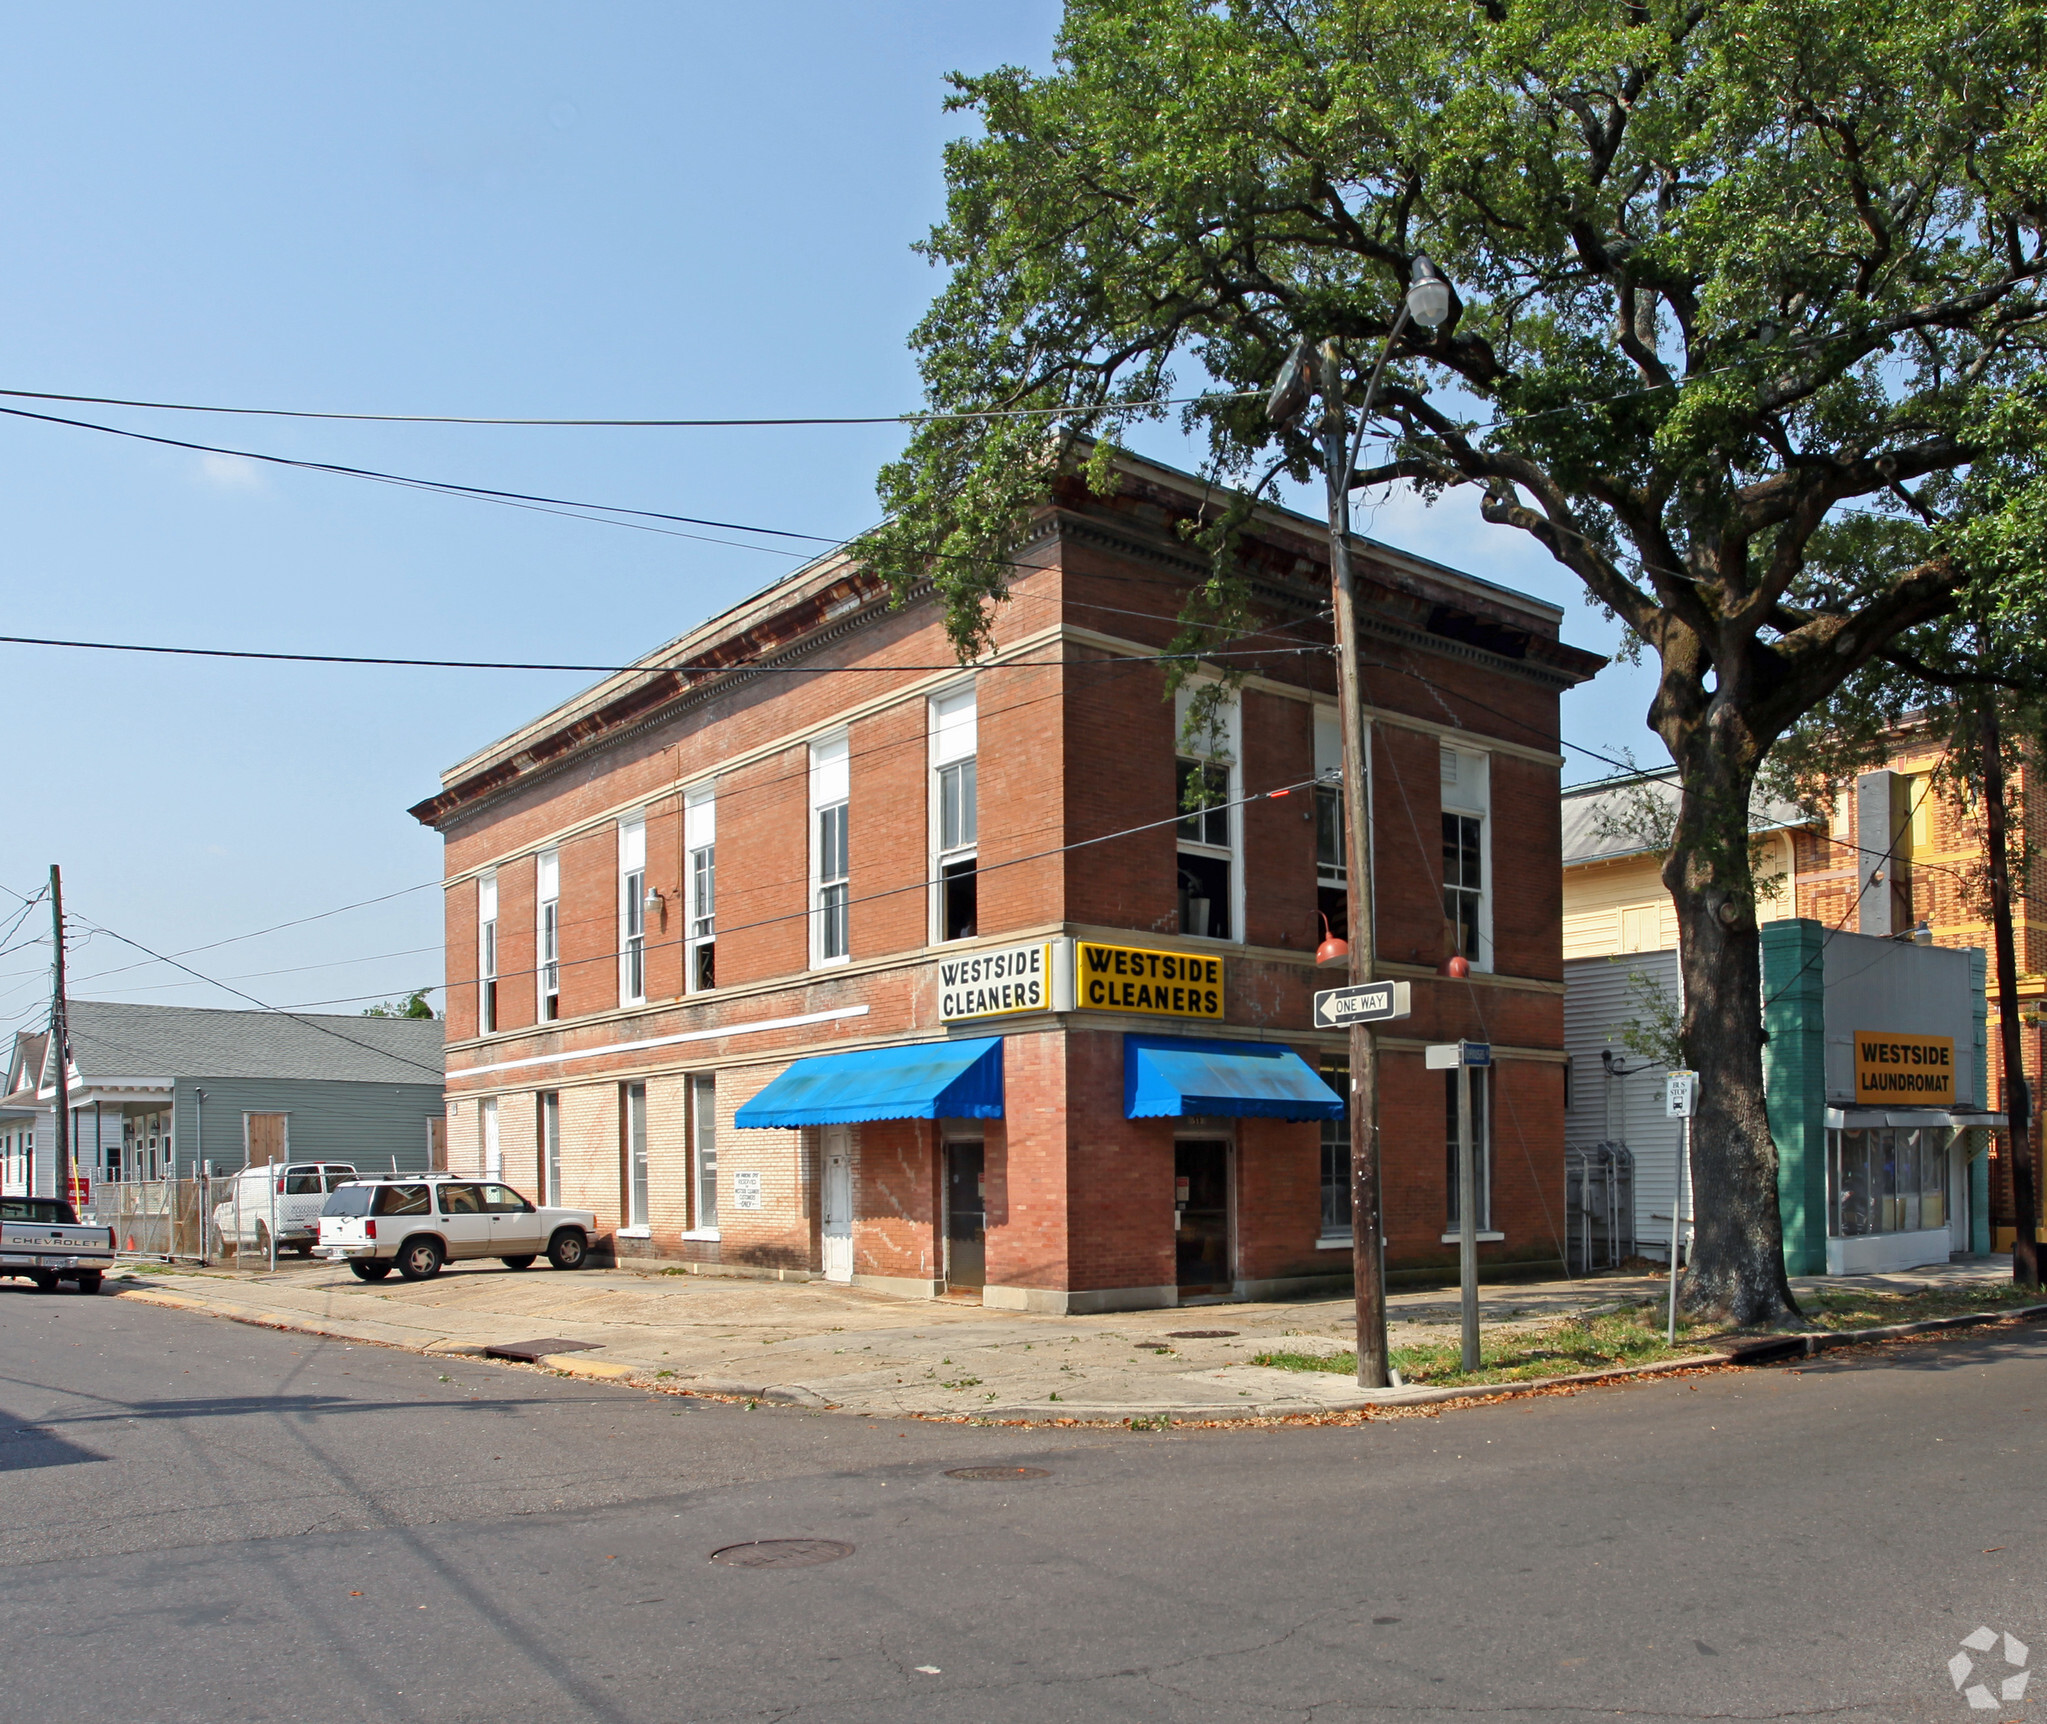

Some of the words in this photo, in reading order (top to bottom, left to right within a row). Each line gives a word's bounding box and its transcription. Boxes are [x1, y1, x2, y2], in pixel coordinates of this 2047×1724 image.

[941, 949, 1041, 987] WESTSIDE
[1085, 947, 1218, 984] WESTSIDE
[943, 981, 1041, 1017] CLEANERS
[1089, 980, 1218, 1013] CLEANERS
[1336, 998, 1357, 1013] ONE
[1361, 994, 1384, 1010] WAY
[1861, 1043, 1949, 1066] WESTSIDE
[1862, 1072, 1949, 1092] LAUNDROMAT
[12, 1237, 100, 1247] CHEVROLET
